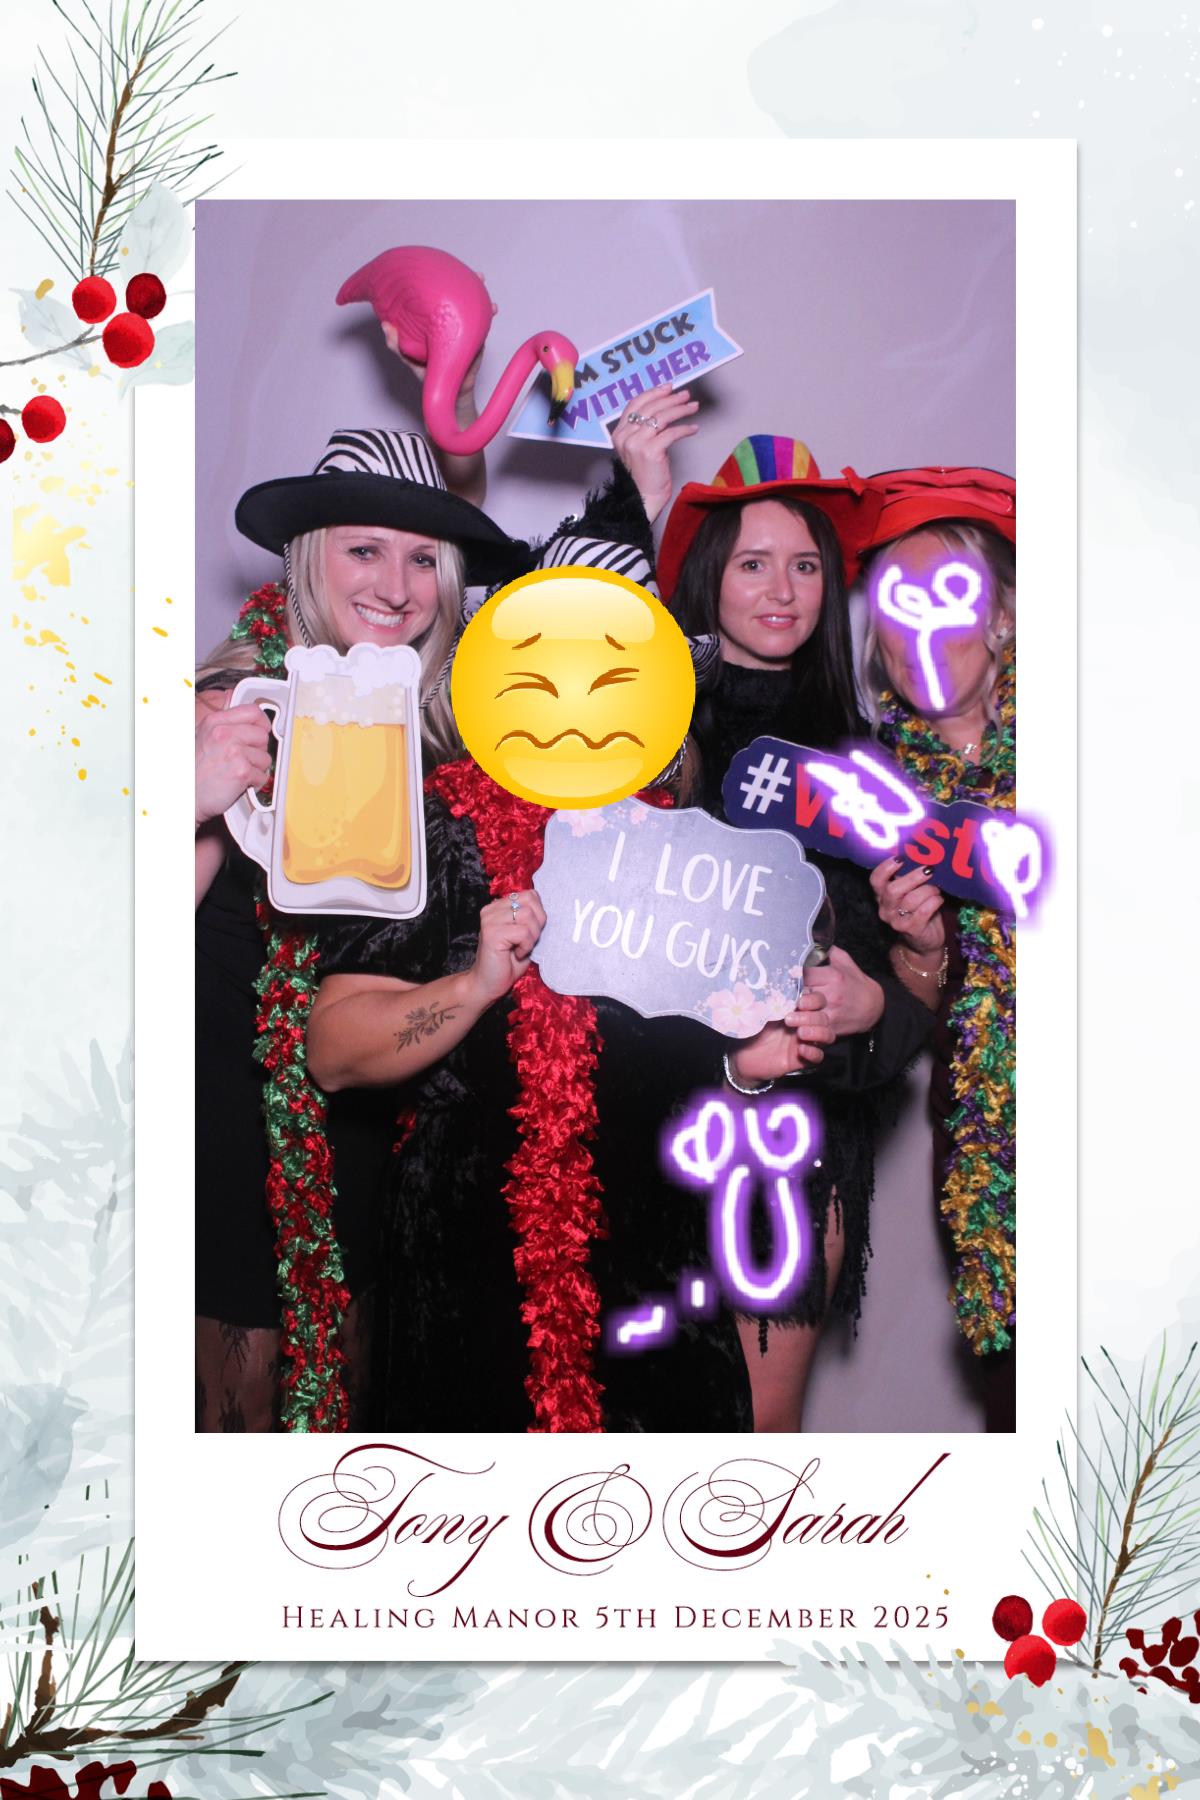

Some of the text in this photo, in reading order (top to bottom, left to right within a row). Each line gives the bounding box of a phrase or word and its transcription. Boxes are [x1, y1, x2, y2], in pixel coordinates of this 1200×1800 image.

[561, 340, 711, 430] WITH HER
[601, 312, 695, 375] STUCK
[608, 831, 773, 916] I LOVE
[572, 899, 770, 989] YOU GUYS
